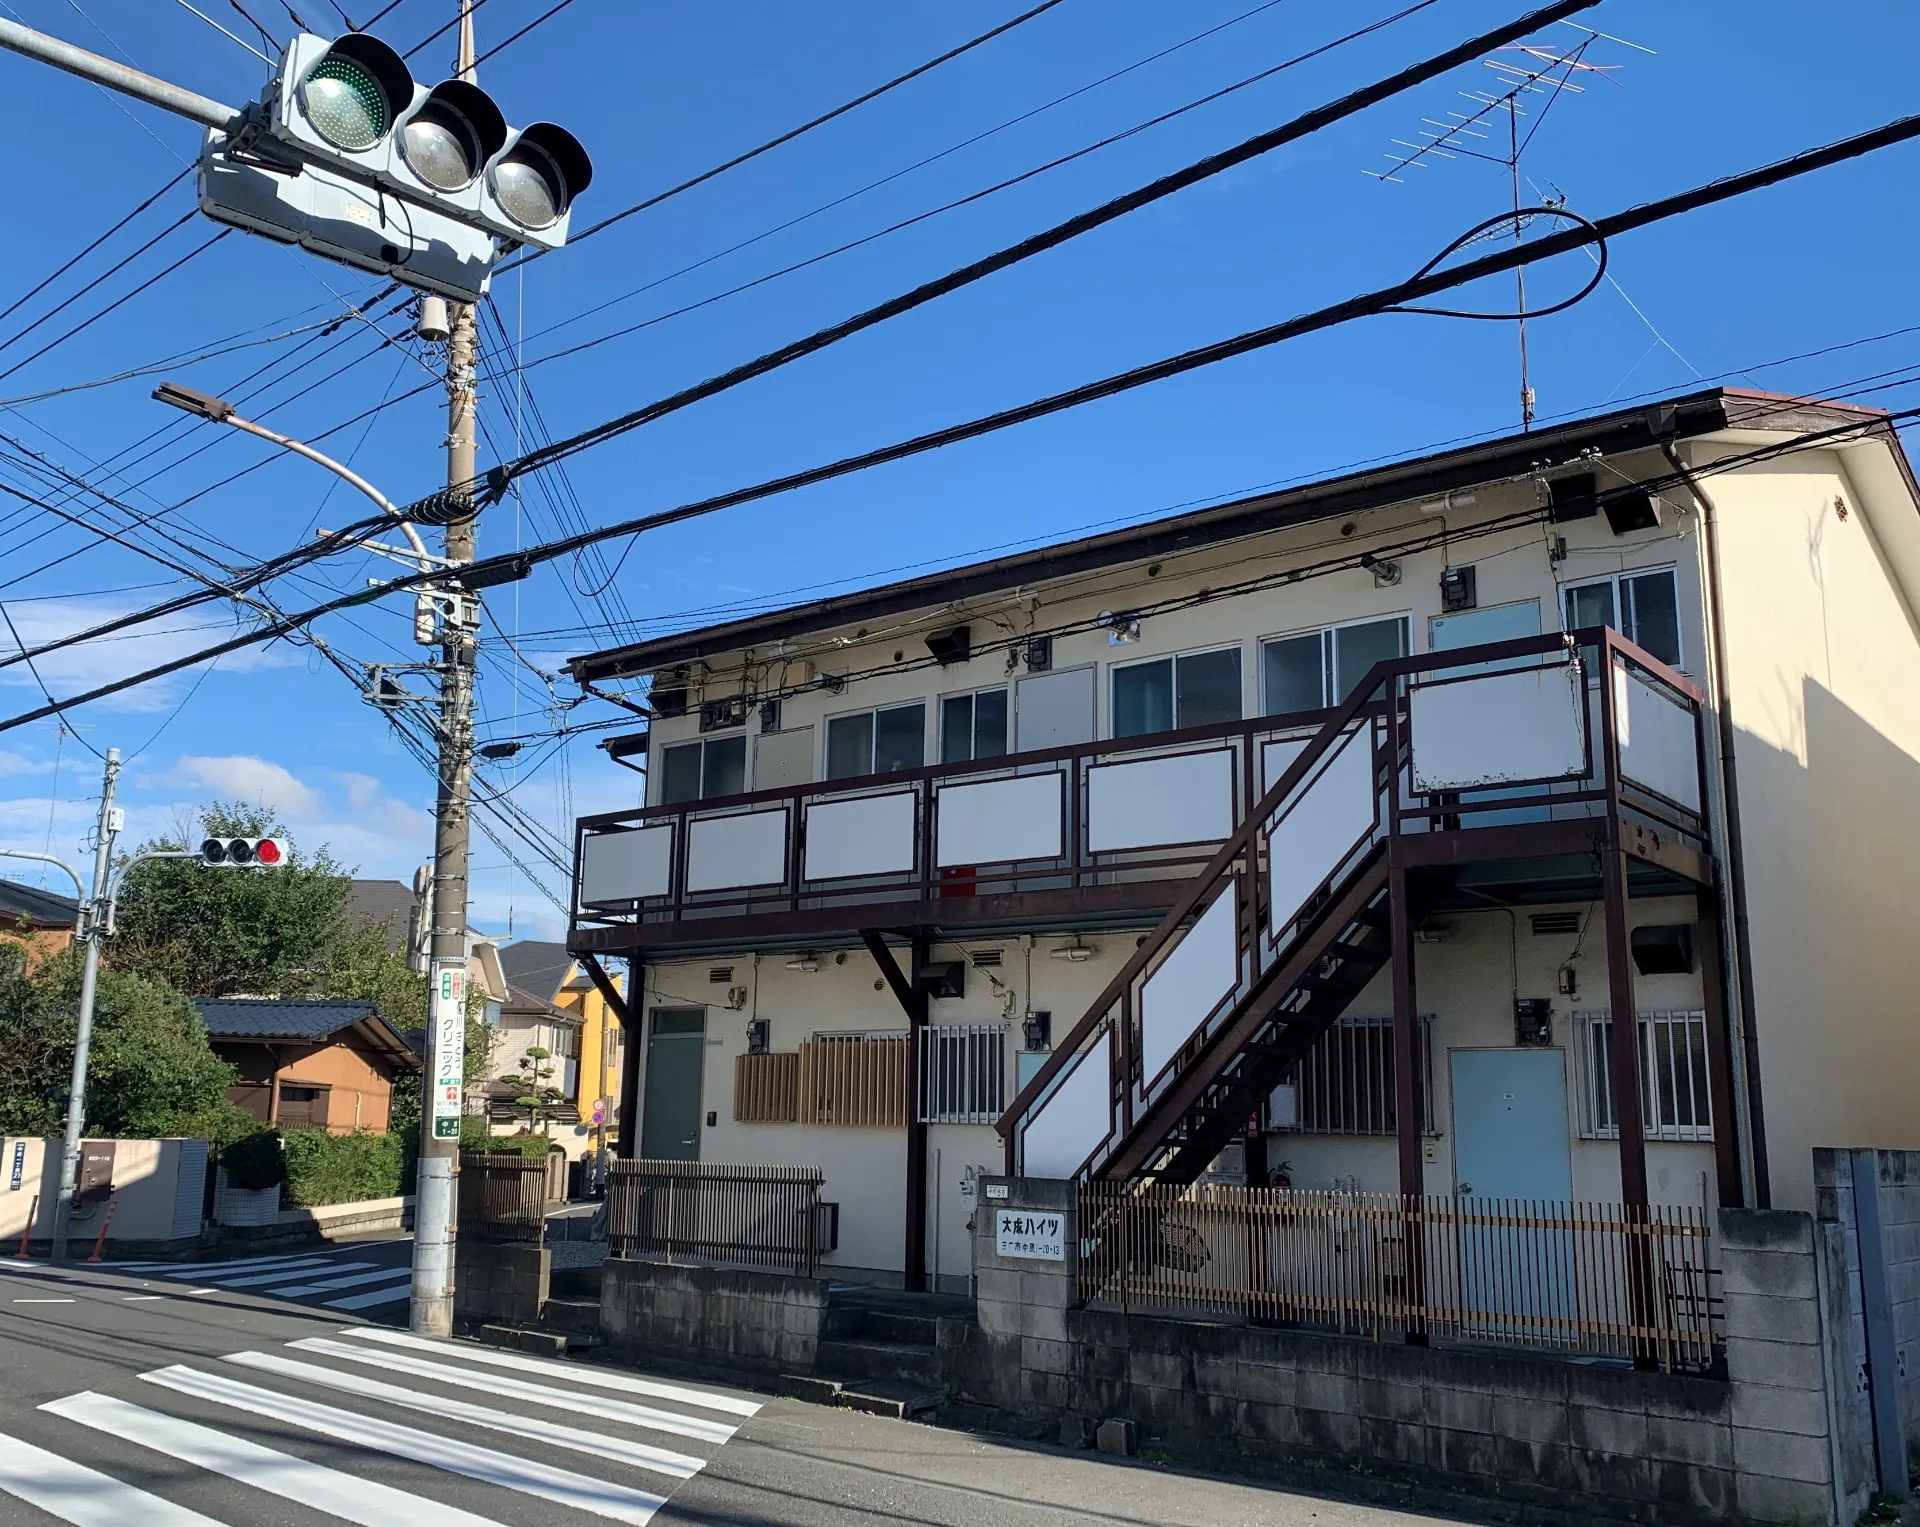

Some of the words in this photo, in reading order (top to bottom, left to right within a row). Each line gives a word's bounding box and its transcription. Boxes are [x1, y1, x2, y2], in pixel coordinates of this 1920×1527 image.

[442, 1019, 453, 1077] クリニック
[1002, 1216, 1059, 1237] 大成ハイツ
